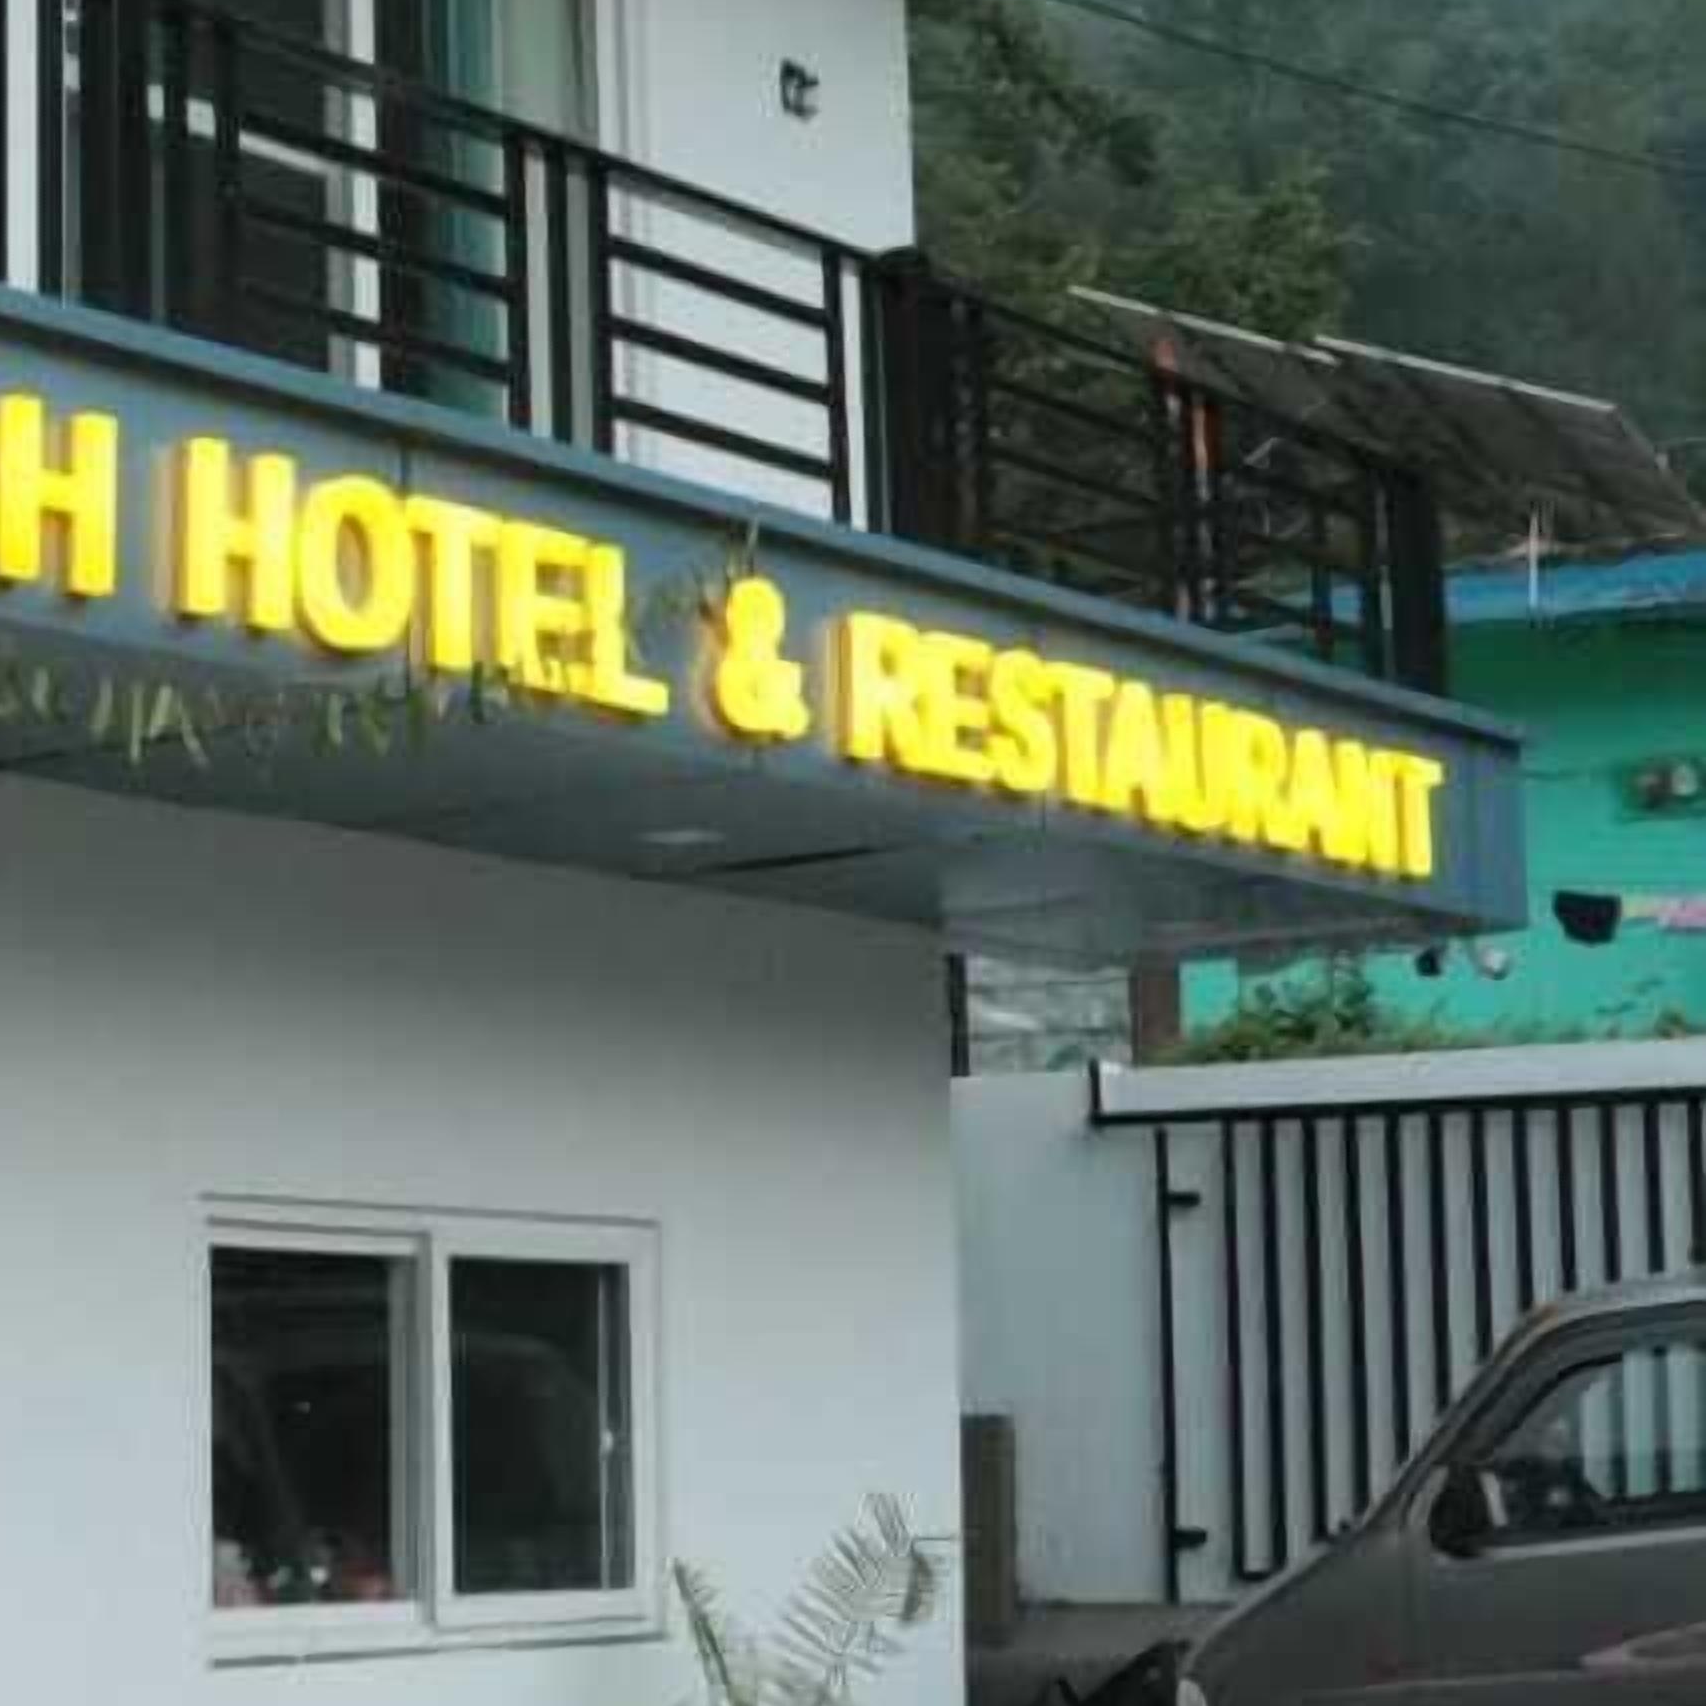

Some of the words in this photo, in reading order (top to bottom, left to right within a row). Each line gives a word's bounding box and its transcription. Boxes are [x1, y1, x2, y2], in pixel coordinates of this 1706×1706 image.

[175, 436, 669, 716] HOTEL
[710, 574, 810, 740] &
[838, 609, 1444, 880] RESTAURANT
